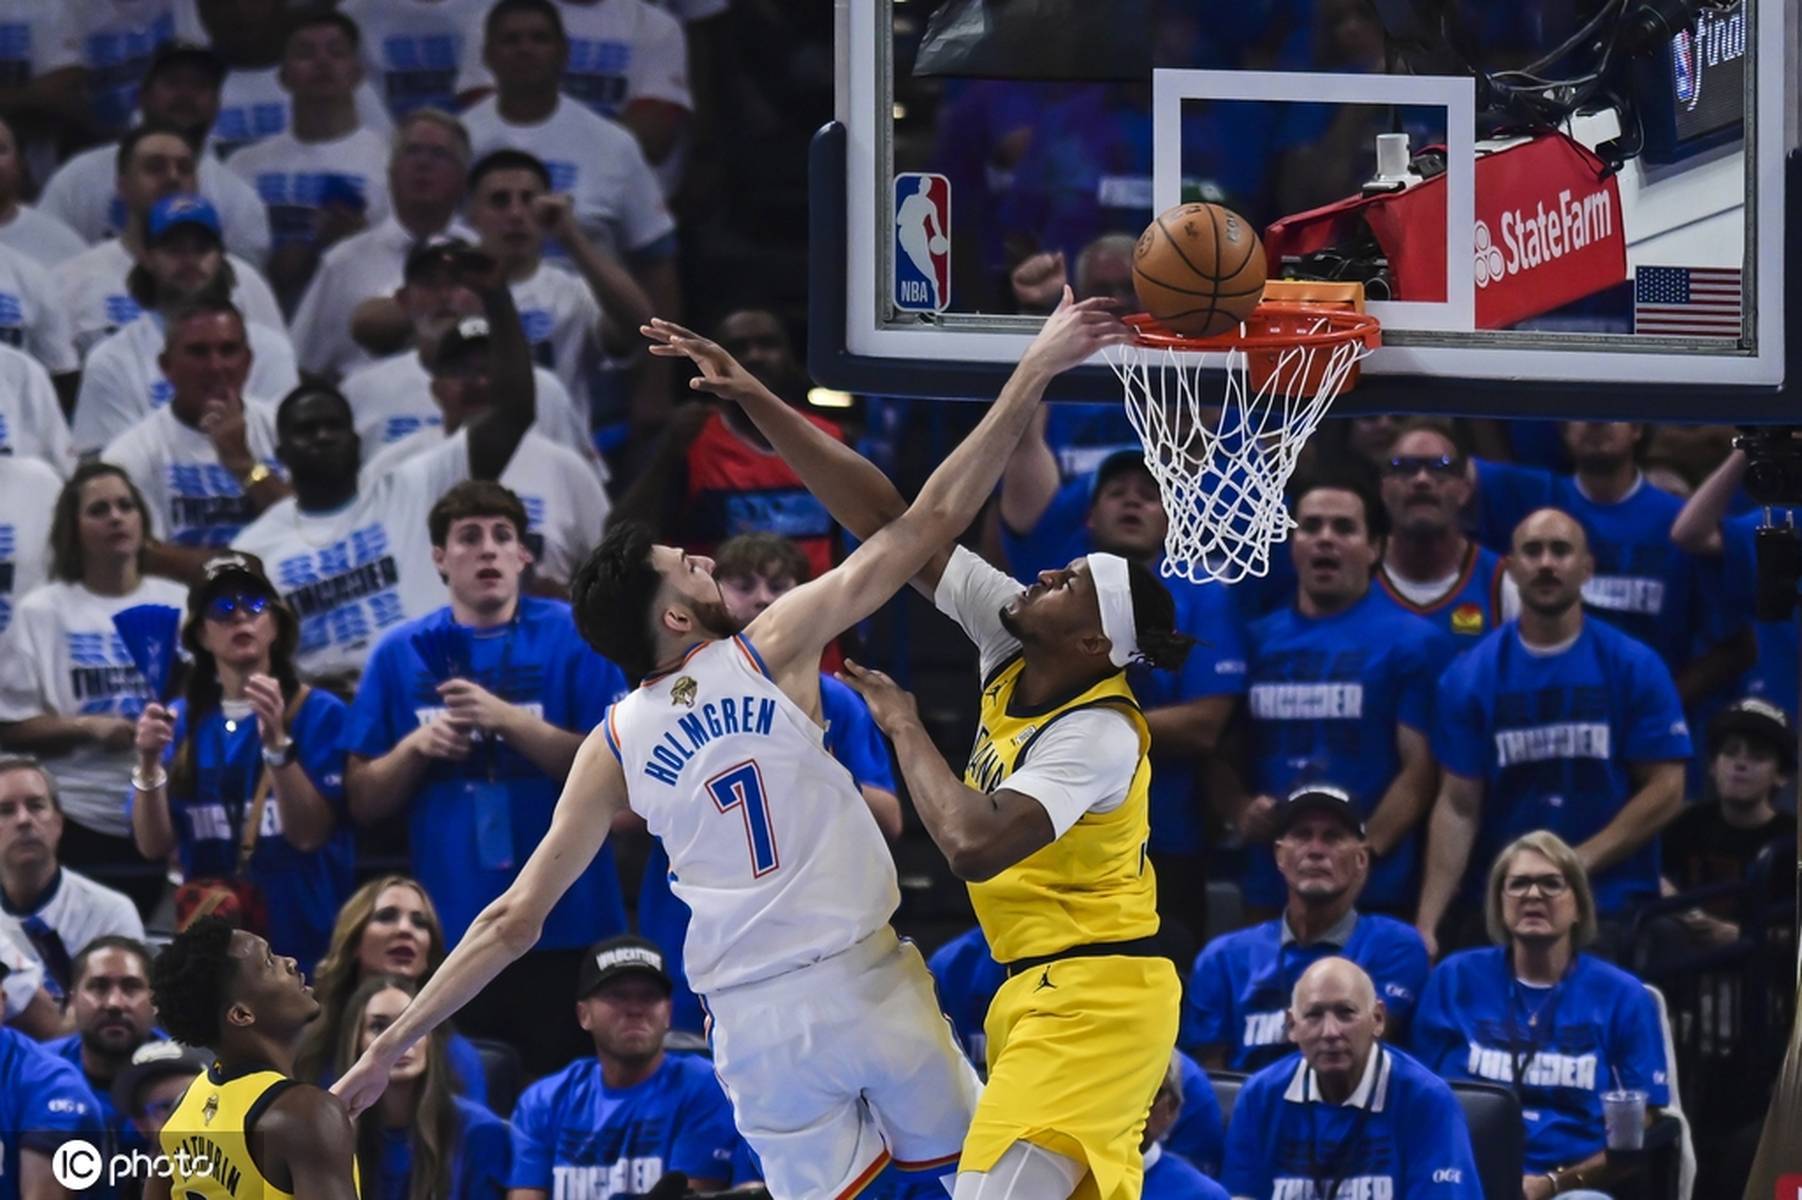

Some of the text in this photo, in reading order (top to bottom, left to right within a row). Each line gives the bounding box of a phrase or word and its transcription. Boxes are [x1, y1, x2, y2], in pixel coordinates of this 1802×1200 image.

[901, 281, 928, 302] NBA
[644, 696, 776, 787] HOLMGREN
[704, 758, 780, 880] 7
